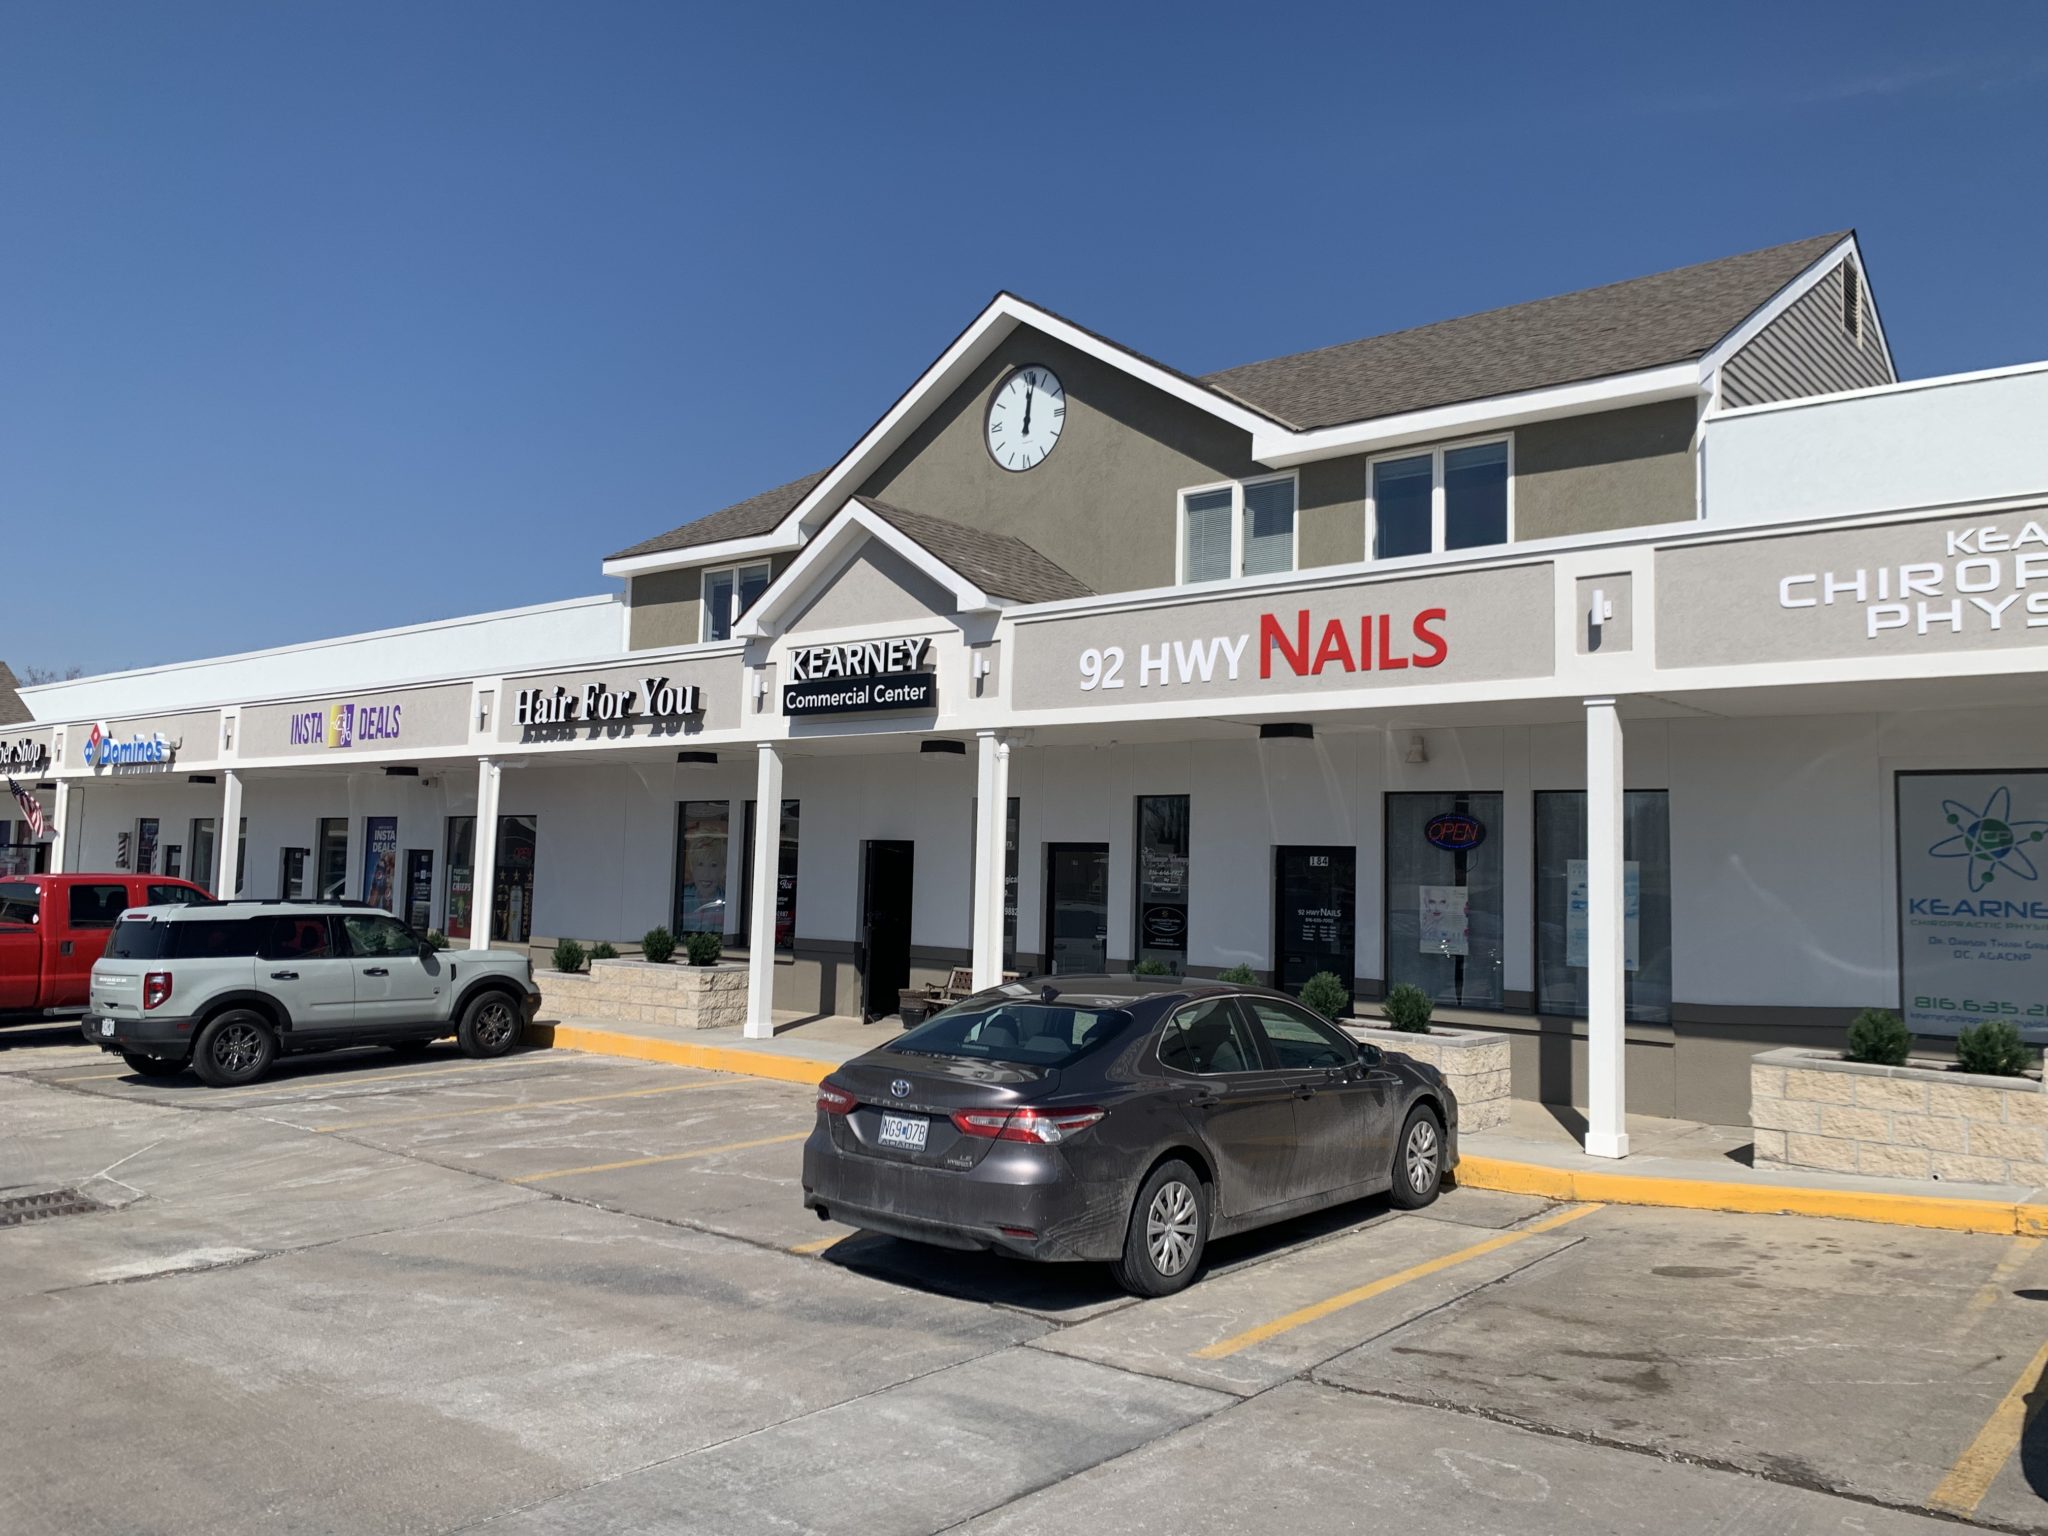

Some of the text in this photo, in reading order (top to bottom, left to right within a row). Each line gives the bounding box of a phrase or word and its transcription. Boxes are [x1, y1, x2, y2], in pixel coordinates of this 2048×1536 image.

[1946, 521, 2048, 557] KEA
[790, 637, 927, 681] KEARNEY
[1079, 607, 1449, 692] 92 HWY NAILS
[511, 676, 694, 726] Hair For You
[786, 684, 927, 709] Commercial Center
[290, 704, 402, 745] INSTA DEALS
[15, 738, 41, 768] Shop
[100, 732, 163, 765] Domino's
[374, 830, 396, 841] INSTA
[1428, 822, 1478, 842] OPEN
[372, 842, 396, 853] DEALS
[1310, 856, 1328, 866] 184
[452, 883, 472, 892] CHIEFS
[1320, 907, 1342, 917] NAILS
[1909, 898, 2048, 919] KEARNE
[1910, 918, 2002, 929] CHIROPRACTIC
[1914, 995, 2048, 1017] 816.635.2
[882, 1118, 903, 1139] NG9
